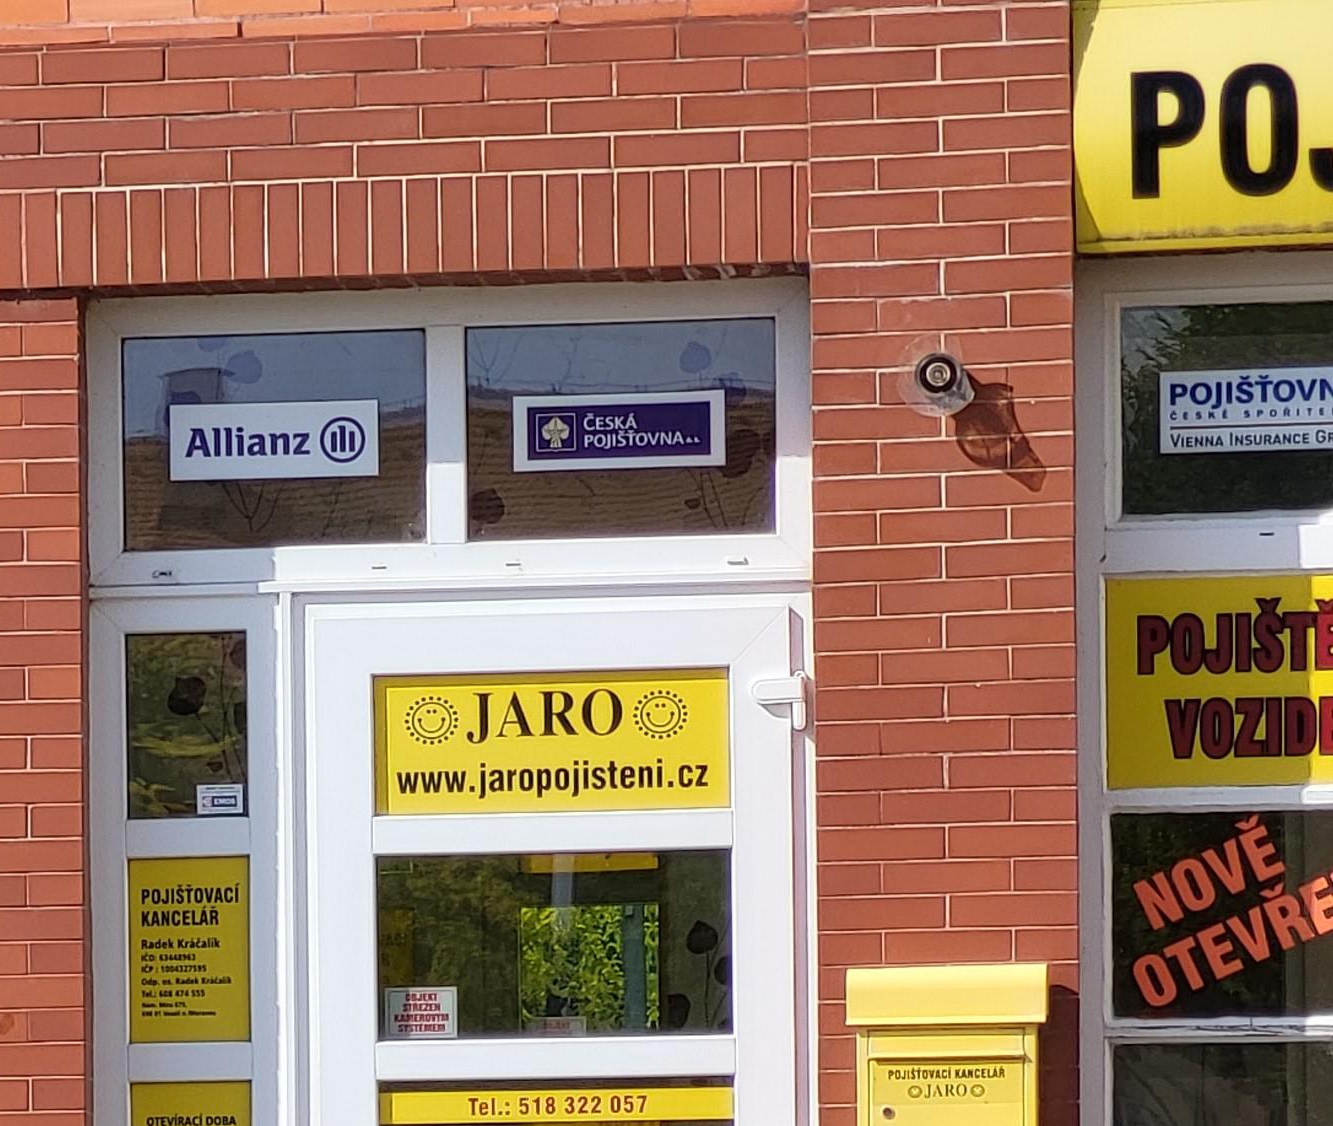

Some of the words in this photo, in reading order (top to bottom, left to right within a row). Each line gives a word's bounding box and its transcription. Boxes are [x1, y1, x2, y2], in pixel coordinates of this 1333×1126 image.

[583, 412, 638, 431] ČESKÁ
[1169, 409, 1229, 421] ČESKÉ
[1243, 407, 1333, 419] SPOŘITE
[184, 426, 312, 459] Allianz
[583, 429, 684, 449] POJIŠŤOVNA
[1229, 431, 1310, 447] INSURANCE
[467, 688, 623, 745] JARO
[396, 757, 710, 800] www.jaropojisteni.cz
[1133, 814, 1286, 930] NOVĚ
[141, 883, 240, 905] POJIŠŤOVACÍ
[141, 905, 219, 927] KANCELÁŘ
[141, 938, 174, 949] Radek
[1133, 870, 1333, 1008] OTEVŘE
[887, 1066, 952, 1080] POJIŠŤOVACÍ
[954, 1065, 1006, 1079] KANCELÁŘ
[924, 1083, 968, 1099] JARO
[468, 1098, 511, 1117] Tel.:
[518, 1097, 556, 1116] 518
[564, 1096, 602, 1115] 322
[610, 1095, 648, 1114] 057
[146, 1113, 203, 1126] OTEVÍRACÍ
[205, 1115, 237, 1126] DOBA
